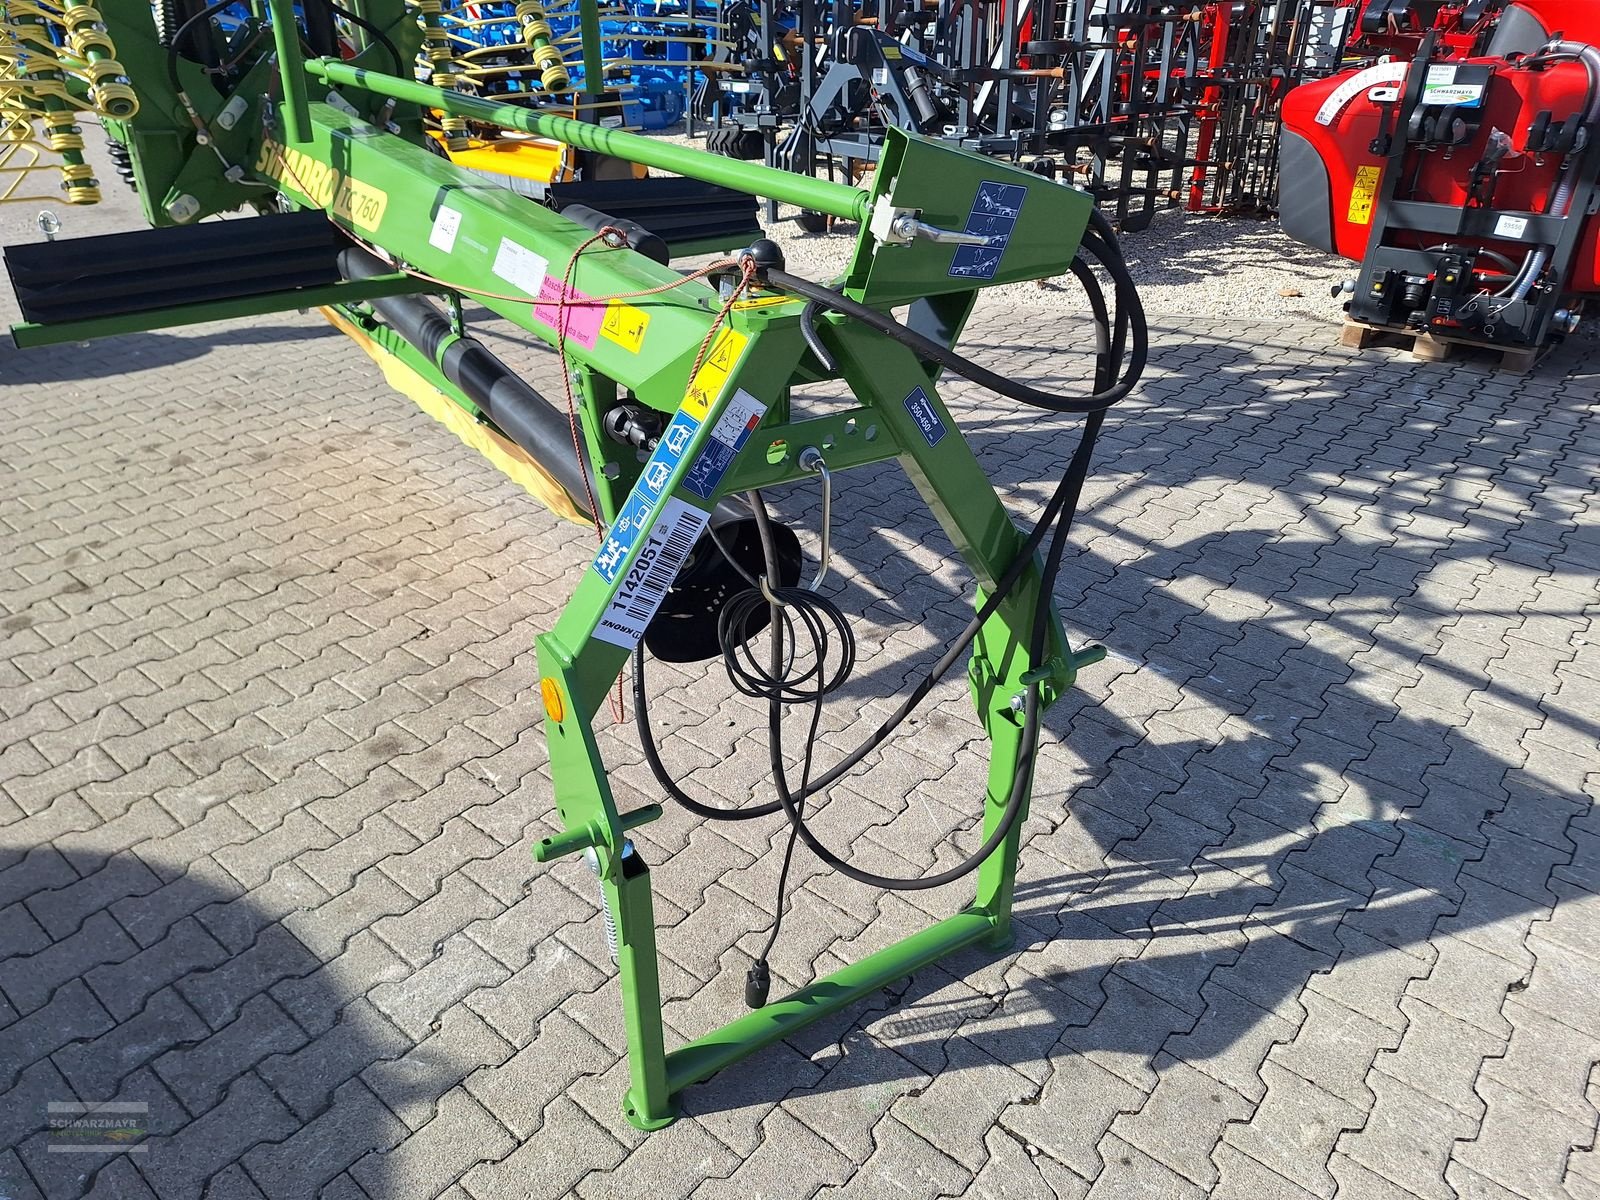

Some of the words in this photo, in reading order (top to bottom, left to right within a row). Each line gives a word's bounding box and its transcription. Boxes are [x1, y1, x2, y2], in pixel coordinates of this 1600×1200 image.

[255, 139, 340, 207] SWADRO
[341, 186, 357, 212] TC
[355, 195, 379, 222] 760
[612, 537, 662, 611] 1142051
[601, 619, 633, 635] KRONE
